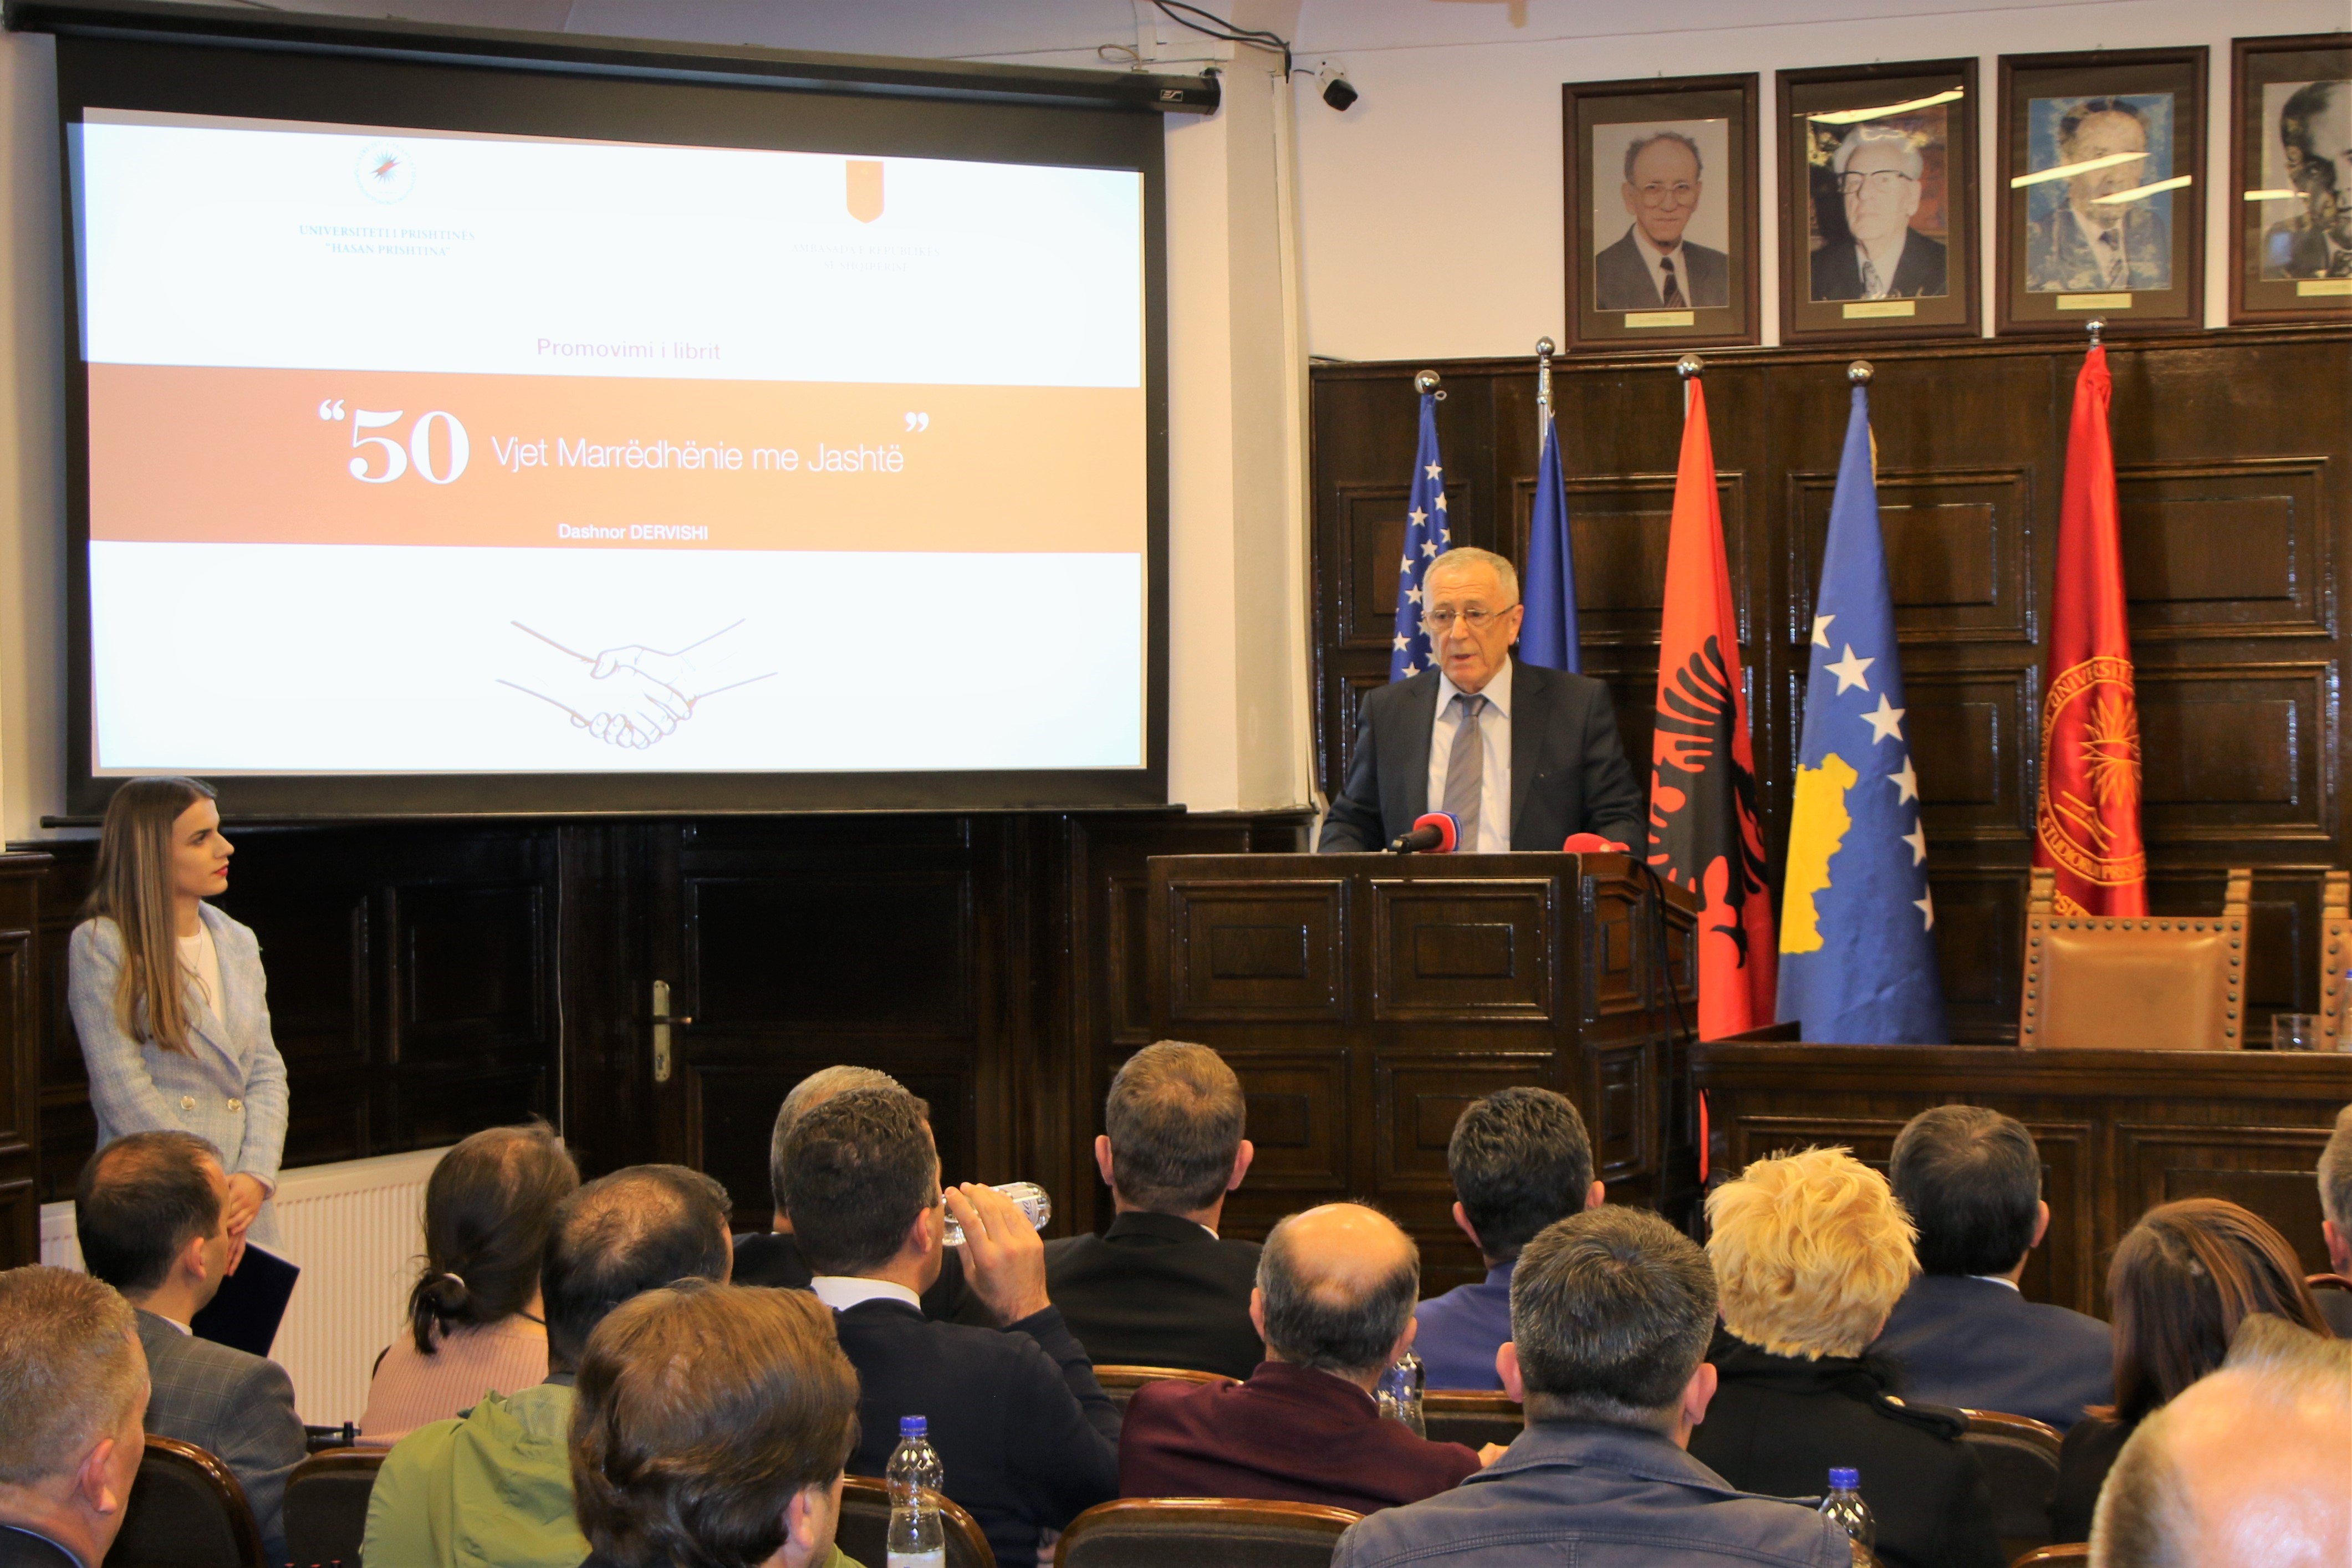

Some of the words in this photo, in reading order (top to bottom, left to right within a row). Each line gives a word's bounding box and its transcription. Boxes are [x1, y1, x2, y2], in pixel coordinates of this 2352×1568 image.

[299, 224, 389, 238] UNIVERSITETI
[392, 228, 397, 238] I
[537, 338, 653, 358] Promovimi
[661, 341, 665, 358] i
[674, 342, 721, 360] librit
[491, 436, 548, 473] Vjet
[557, 437, 743, 470] Marrëdhënie
[752, 448, 799, 471] me
[558, 523, 626, 539] Dashnor
[630, 524, 708, 540] DERVISHI
